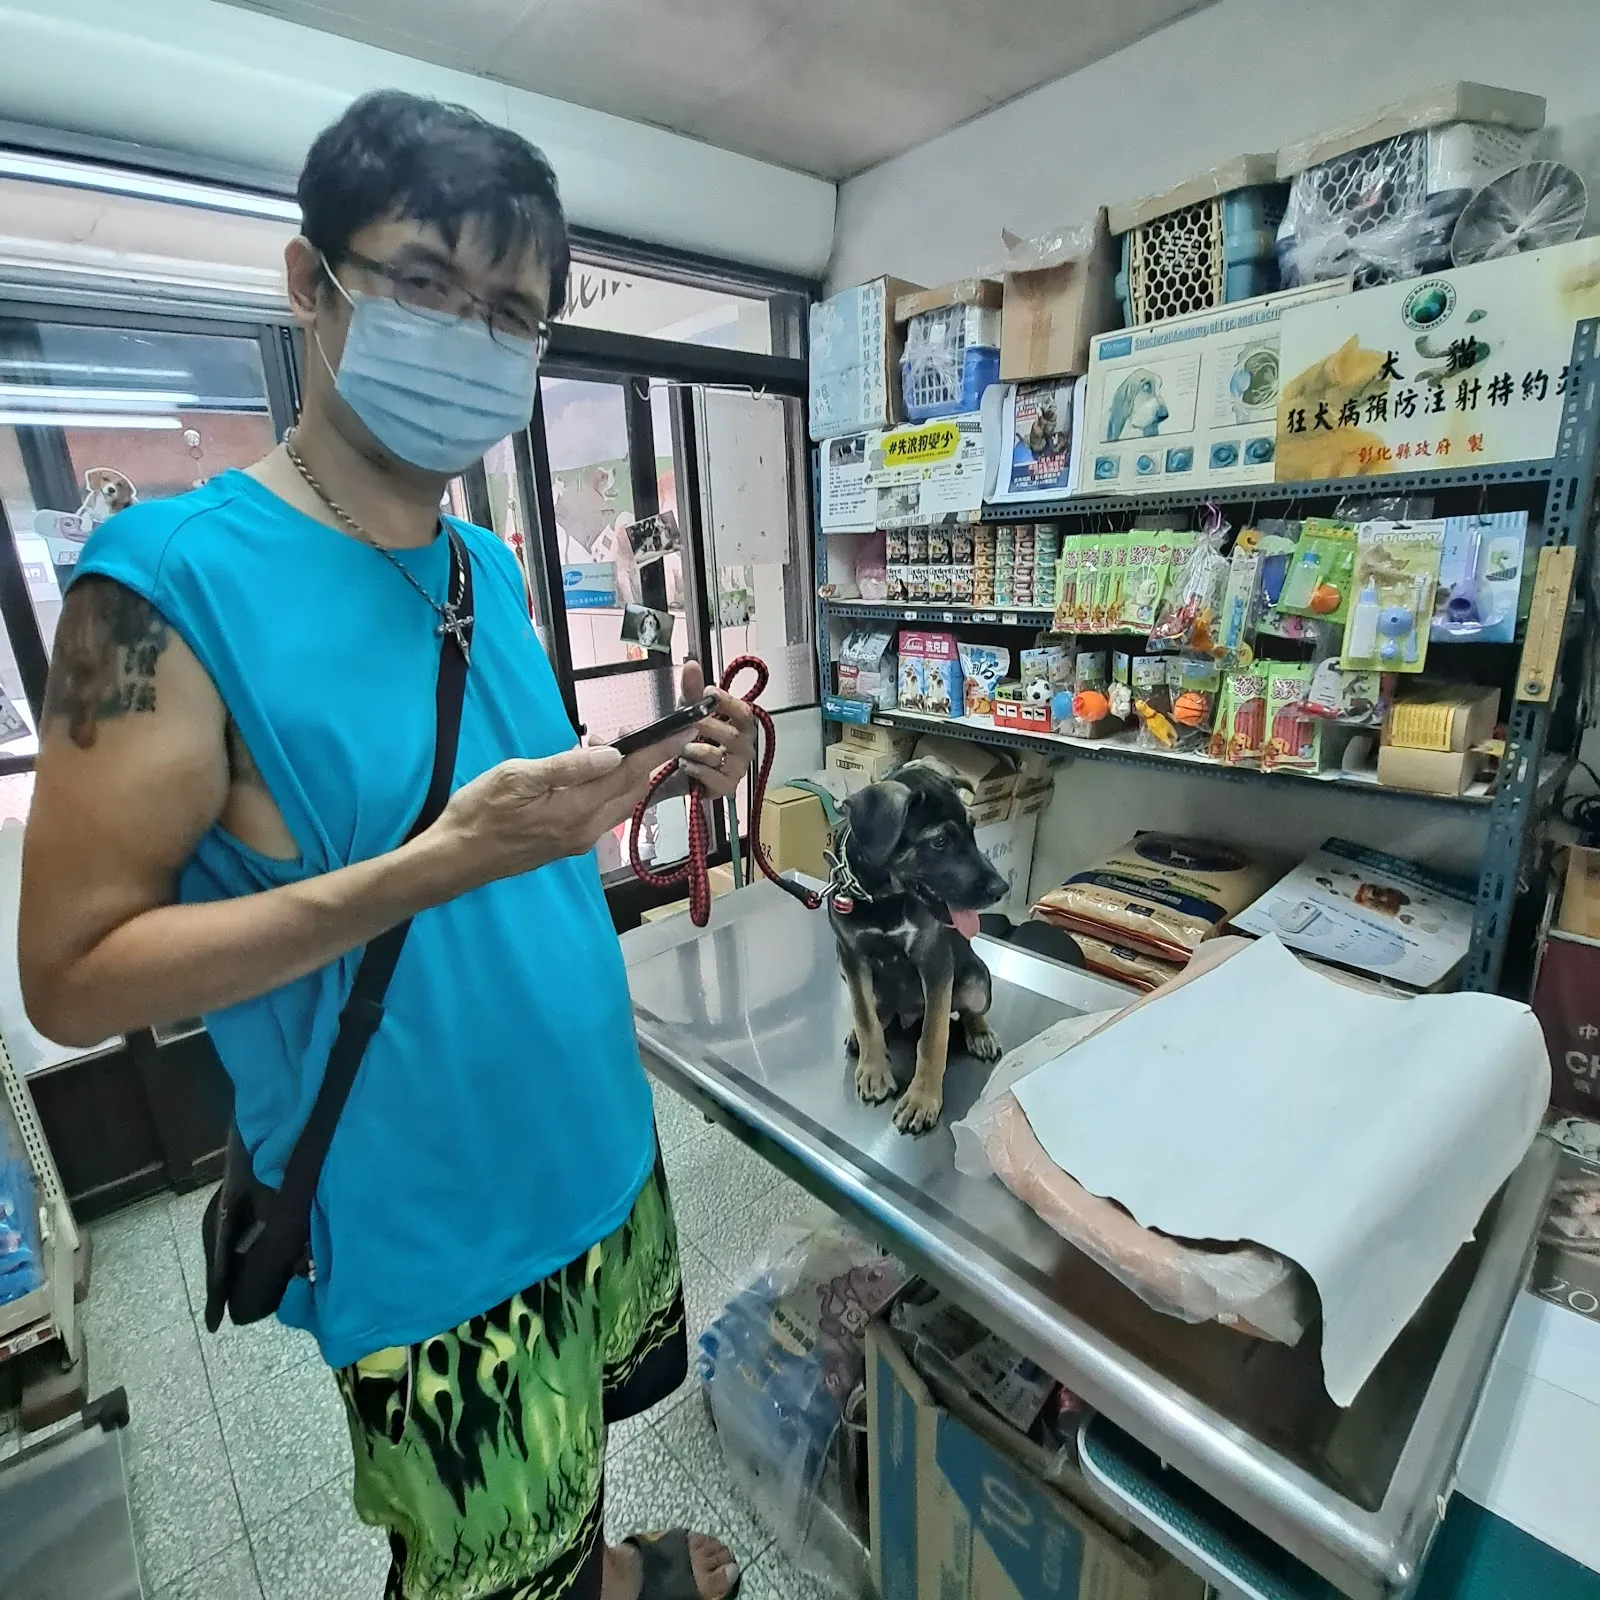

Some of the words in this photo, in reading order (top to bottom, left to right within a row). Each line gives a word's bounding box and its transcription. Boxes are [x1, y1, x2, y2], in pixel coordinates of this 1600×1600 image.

[1220, 318, 1237, 334] Eye
[1237, 312, 1254, 328] and
[1379, 350, 1406, 382] 犬
[1446, 335, 1477, 372] 貓
[1357, 438, 1451, 465] 彰化縣政府
